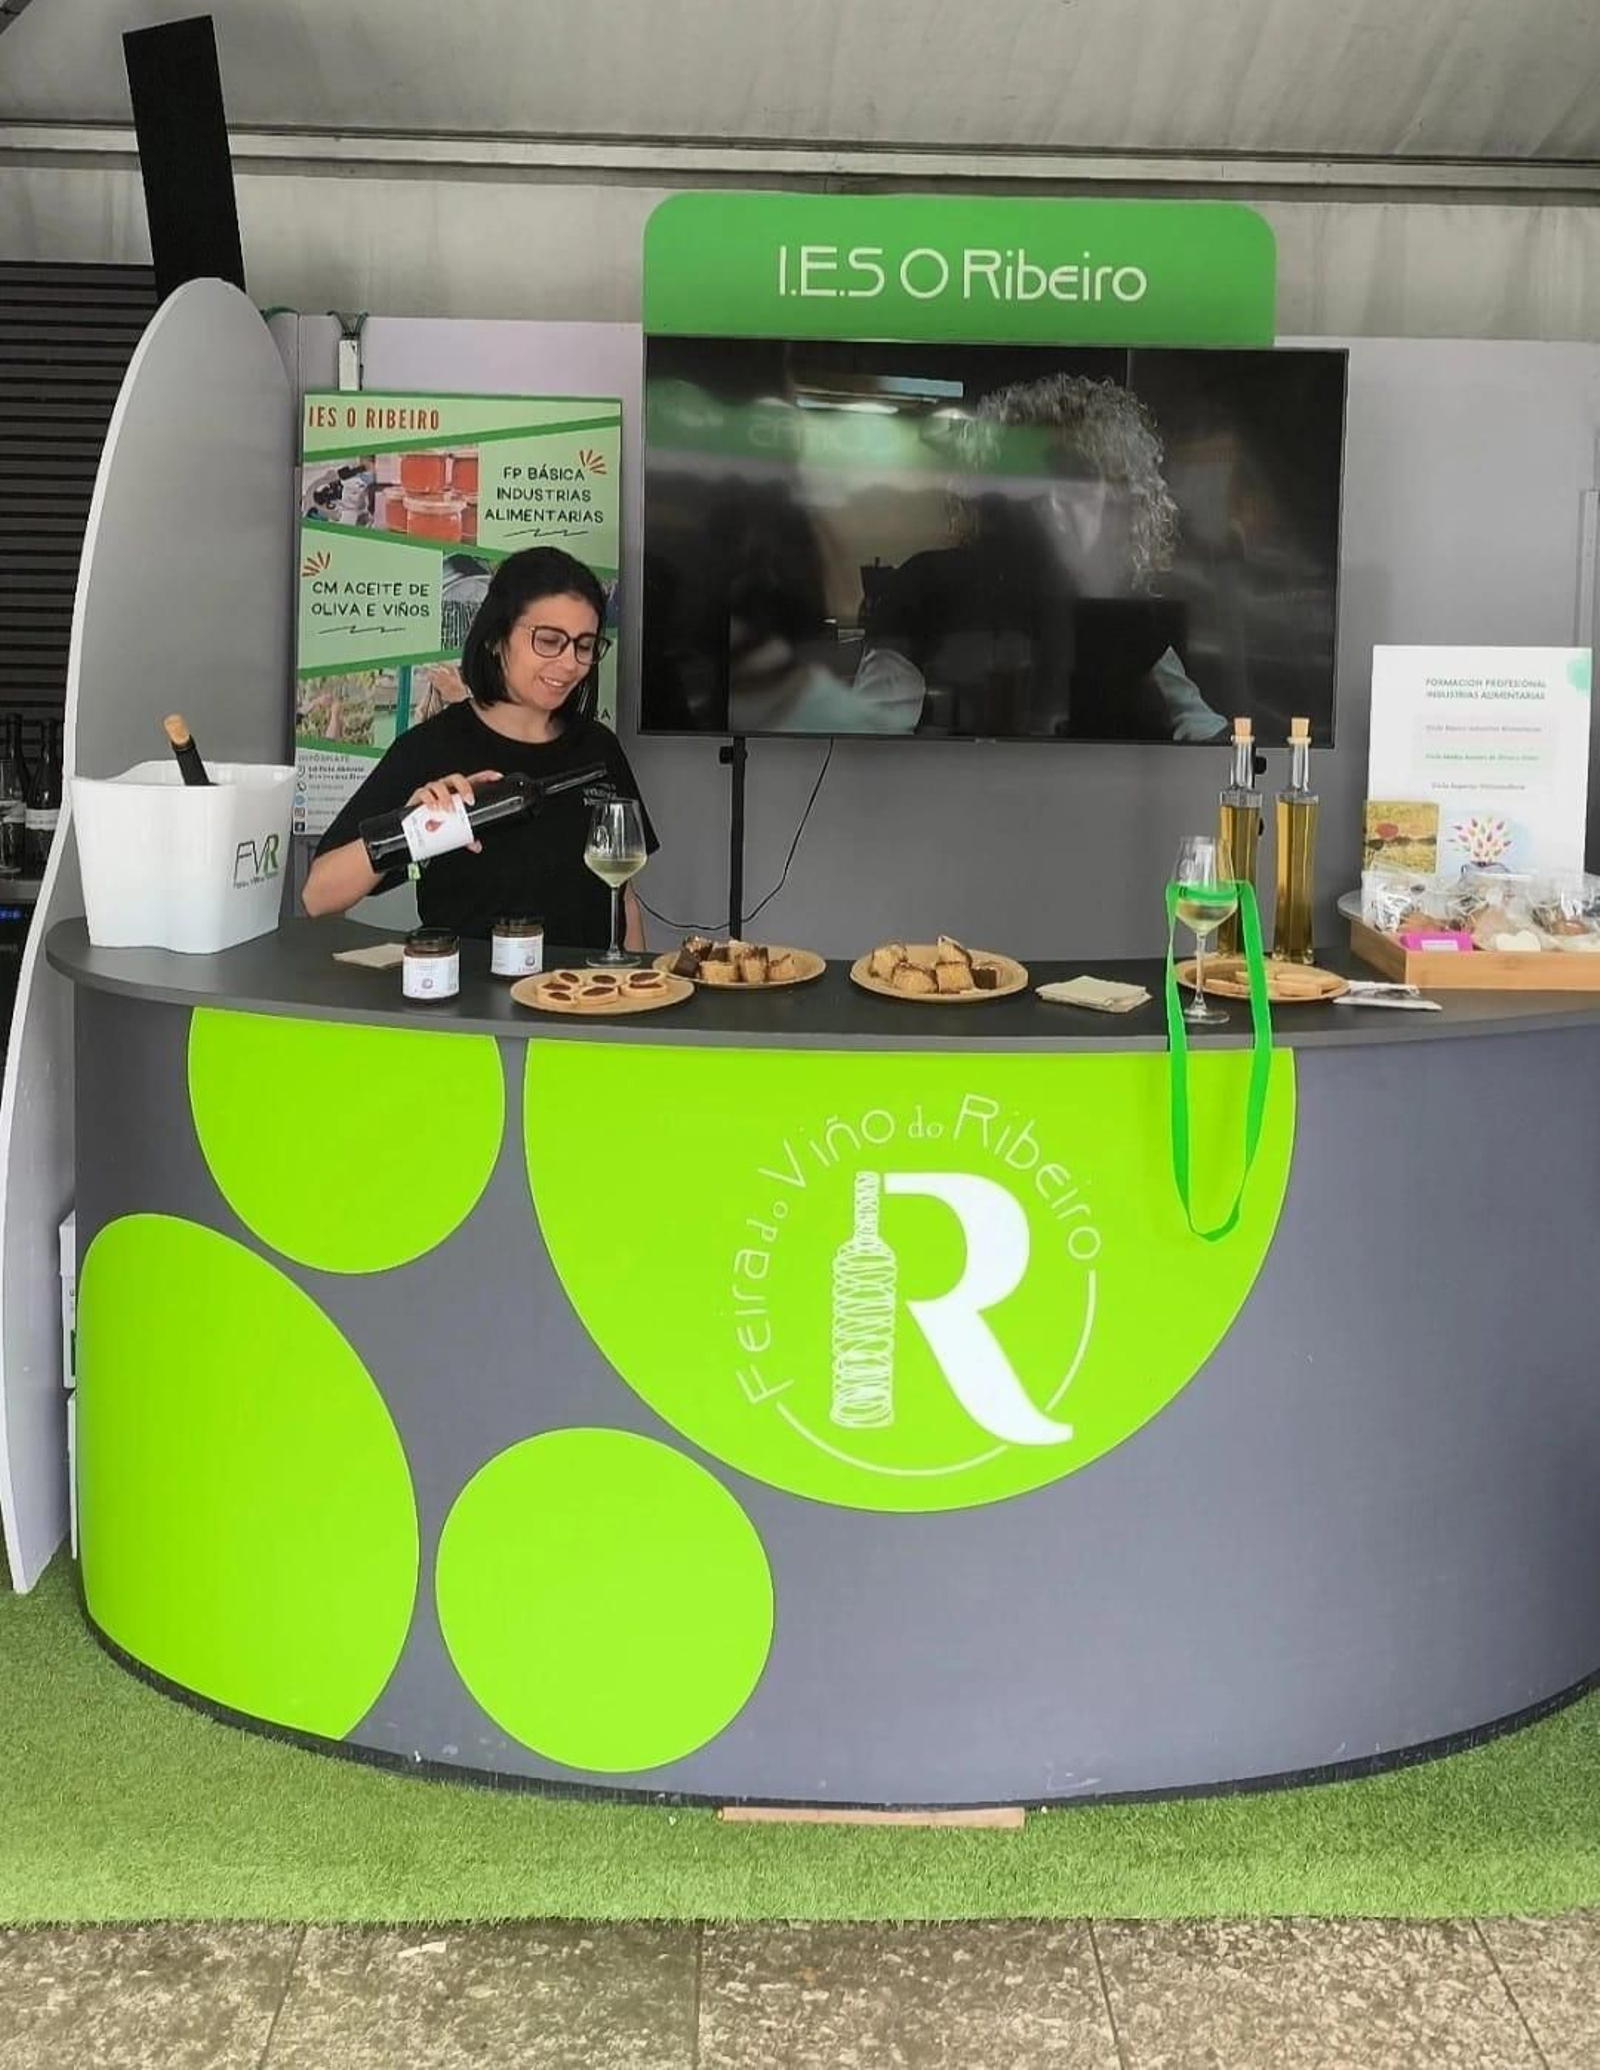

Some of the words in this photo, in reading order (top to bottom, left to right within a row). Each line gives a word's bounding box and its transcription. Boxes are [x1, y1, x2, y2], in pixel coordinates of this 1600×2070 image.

[899, 247, 950, 299] O
[962, 247, 1148, 302] Ribeiro
[308, 406, 338, 428] IES
[346, 407, 357, 428] O
[365, 408, 440, 431] RIBEIRO
[503, 466, 522, 480] FP
[528, 462, 585, 481] BÁSICA
[496, 488, 592, 502] INDUSTRIAS
[483, 508, 604, 523] ALIMENTARIAS
[312, 581, 338, 595] CM
[343, 582, 402, 596] ACEITE
[409, 583, 429, 597] DE
[311, 602, 361, 616] OLIVA
[366, 603, 376, 616] E
[384, 601, 430, 617] VIÑOS
[907, 1104, 944, 1139] do
[758, 1108, 896, 1188] Viño
[953, 1093, 1102, 1260] Ribeiro
[746, 1199, 789, 1242] do
[720, 1247, 794, 1405] Feira
